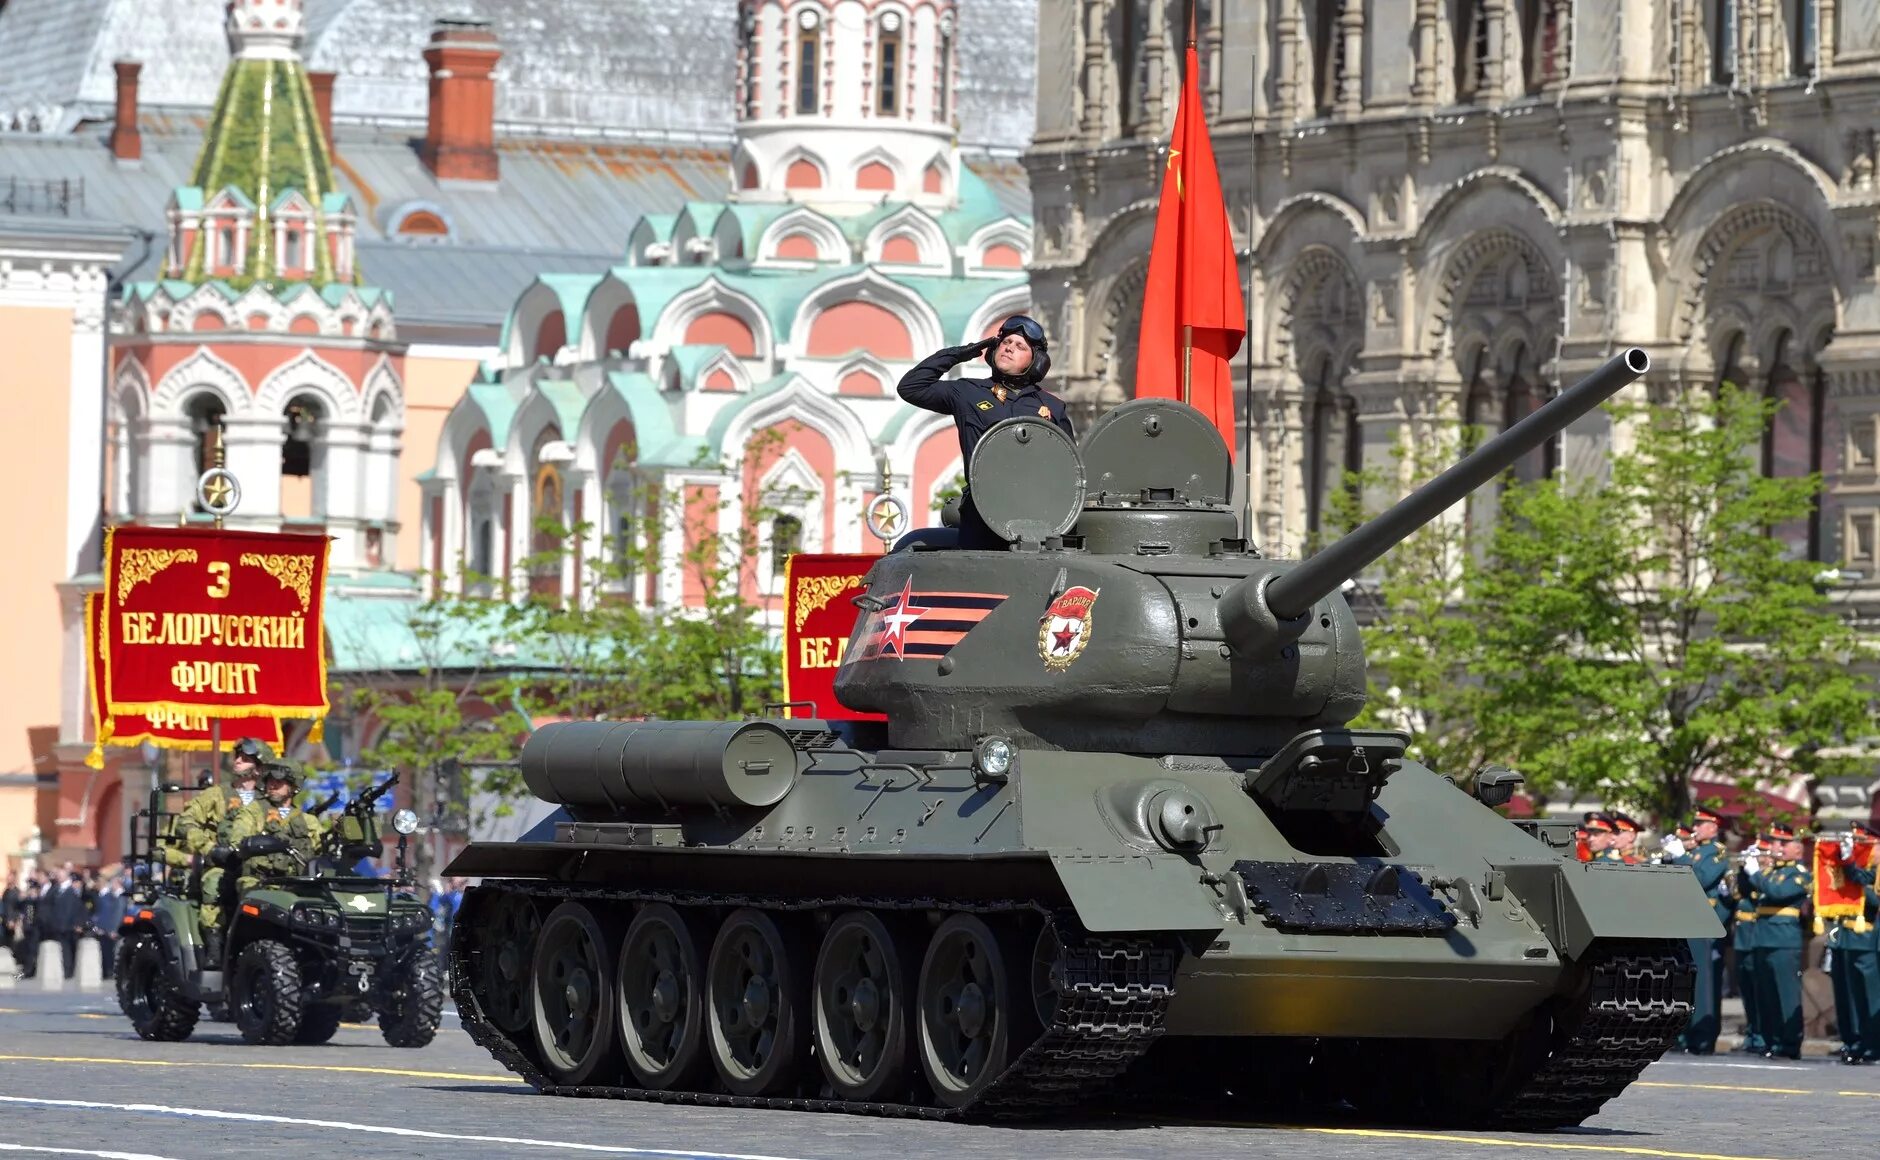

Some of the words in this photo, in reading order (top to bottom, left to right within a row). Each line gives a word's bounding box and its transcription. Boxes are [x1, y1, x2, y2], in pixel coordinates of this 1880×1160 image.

[206, 560, 231, 599] 3
[121, 610, 306, 649] БЕЛОРУССКИЙ
[170, 660, 261, 695] ФРОНТ
